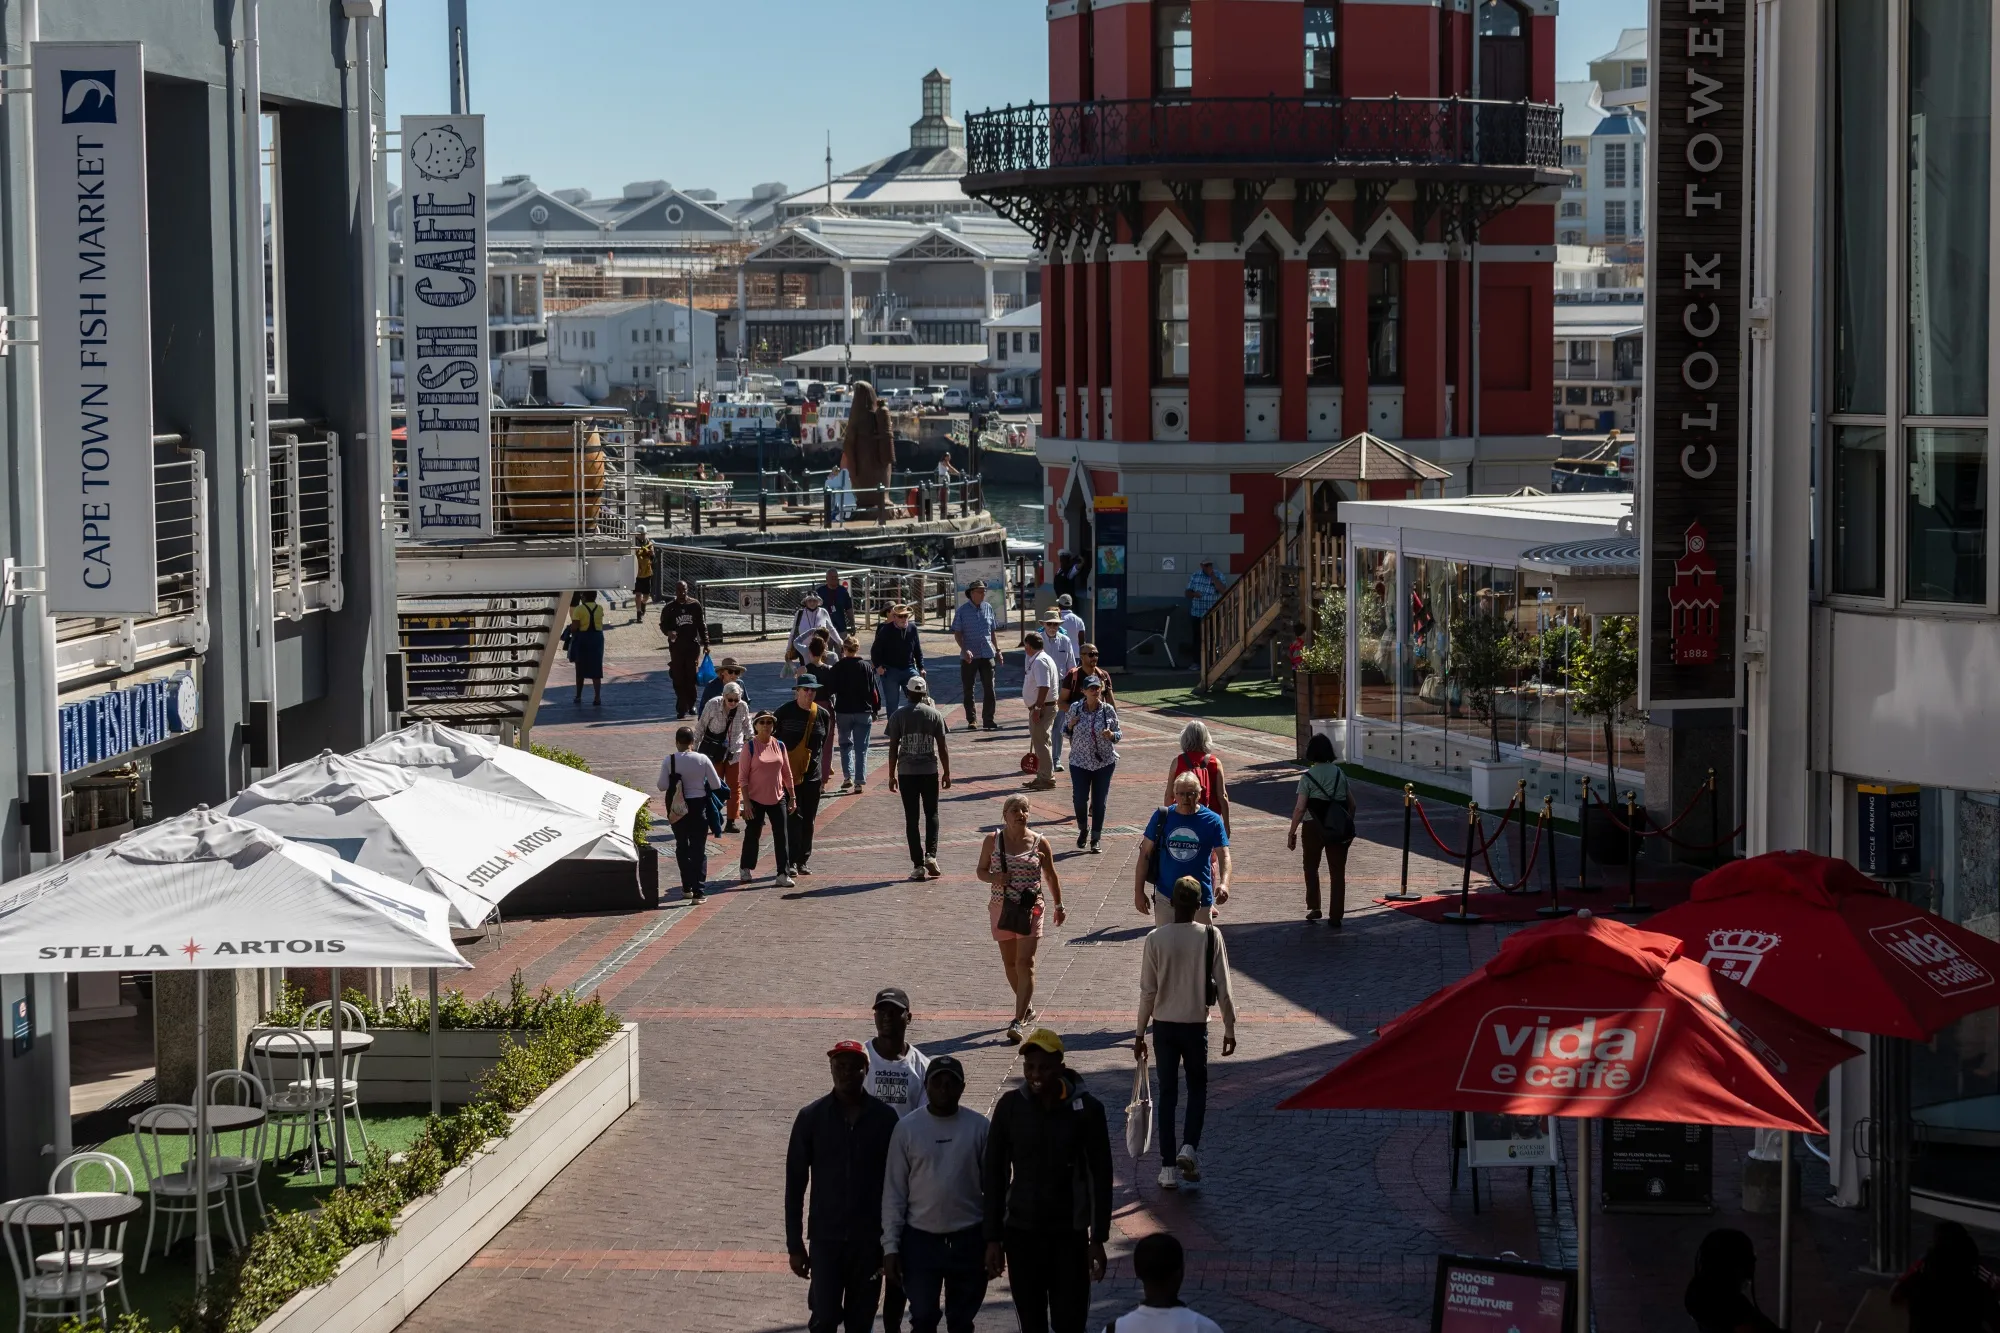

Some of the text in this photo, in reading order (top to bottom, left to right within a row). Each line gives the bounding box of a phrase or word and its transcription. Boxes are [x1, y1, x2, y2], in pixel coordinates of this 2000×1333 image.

[76, 134, 112, 590] CAPE TOWN FISH MARKET
[413, 192, 482, 530] FAT FISH CAFE
[1681, 253, 1721, 480] CLOCK
[421, 653, 457, 663] Robben
[1683, 649, 1708, 658] 1882
[61, 678, 172, 774] FAT FISH CAFE
[1890, 800, 1917, 809] BICYCLE
[1889, 810, 1918, 819] PARKING
[466, 825, 563, 888] STELLA ARTOIS
[38, 939, 347, 960] STELLA ARTOIS
[1886, 929, 1960, 966] vida
[1927, 971, 1949, 986] e
[1493, 1016, 1637, 1061] vida
[875, 1069, 901, 1077] adidas
[1491, 1061, 1631, 1090] e caffè
[876, 1084, 907, 1097] ADIDAS
[1450, 1271, 1495, 1286] CHOOSE
[1449, 1282, 1479, 1296] YOUR
[1448, 1293, 1514, 1311] ADVENTURE
